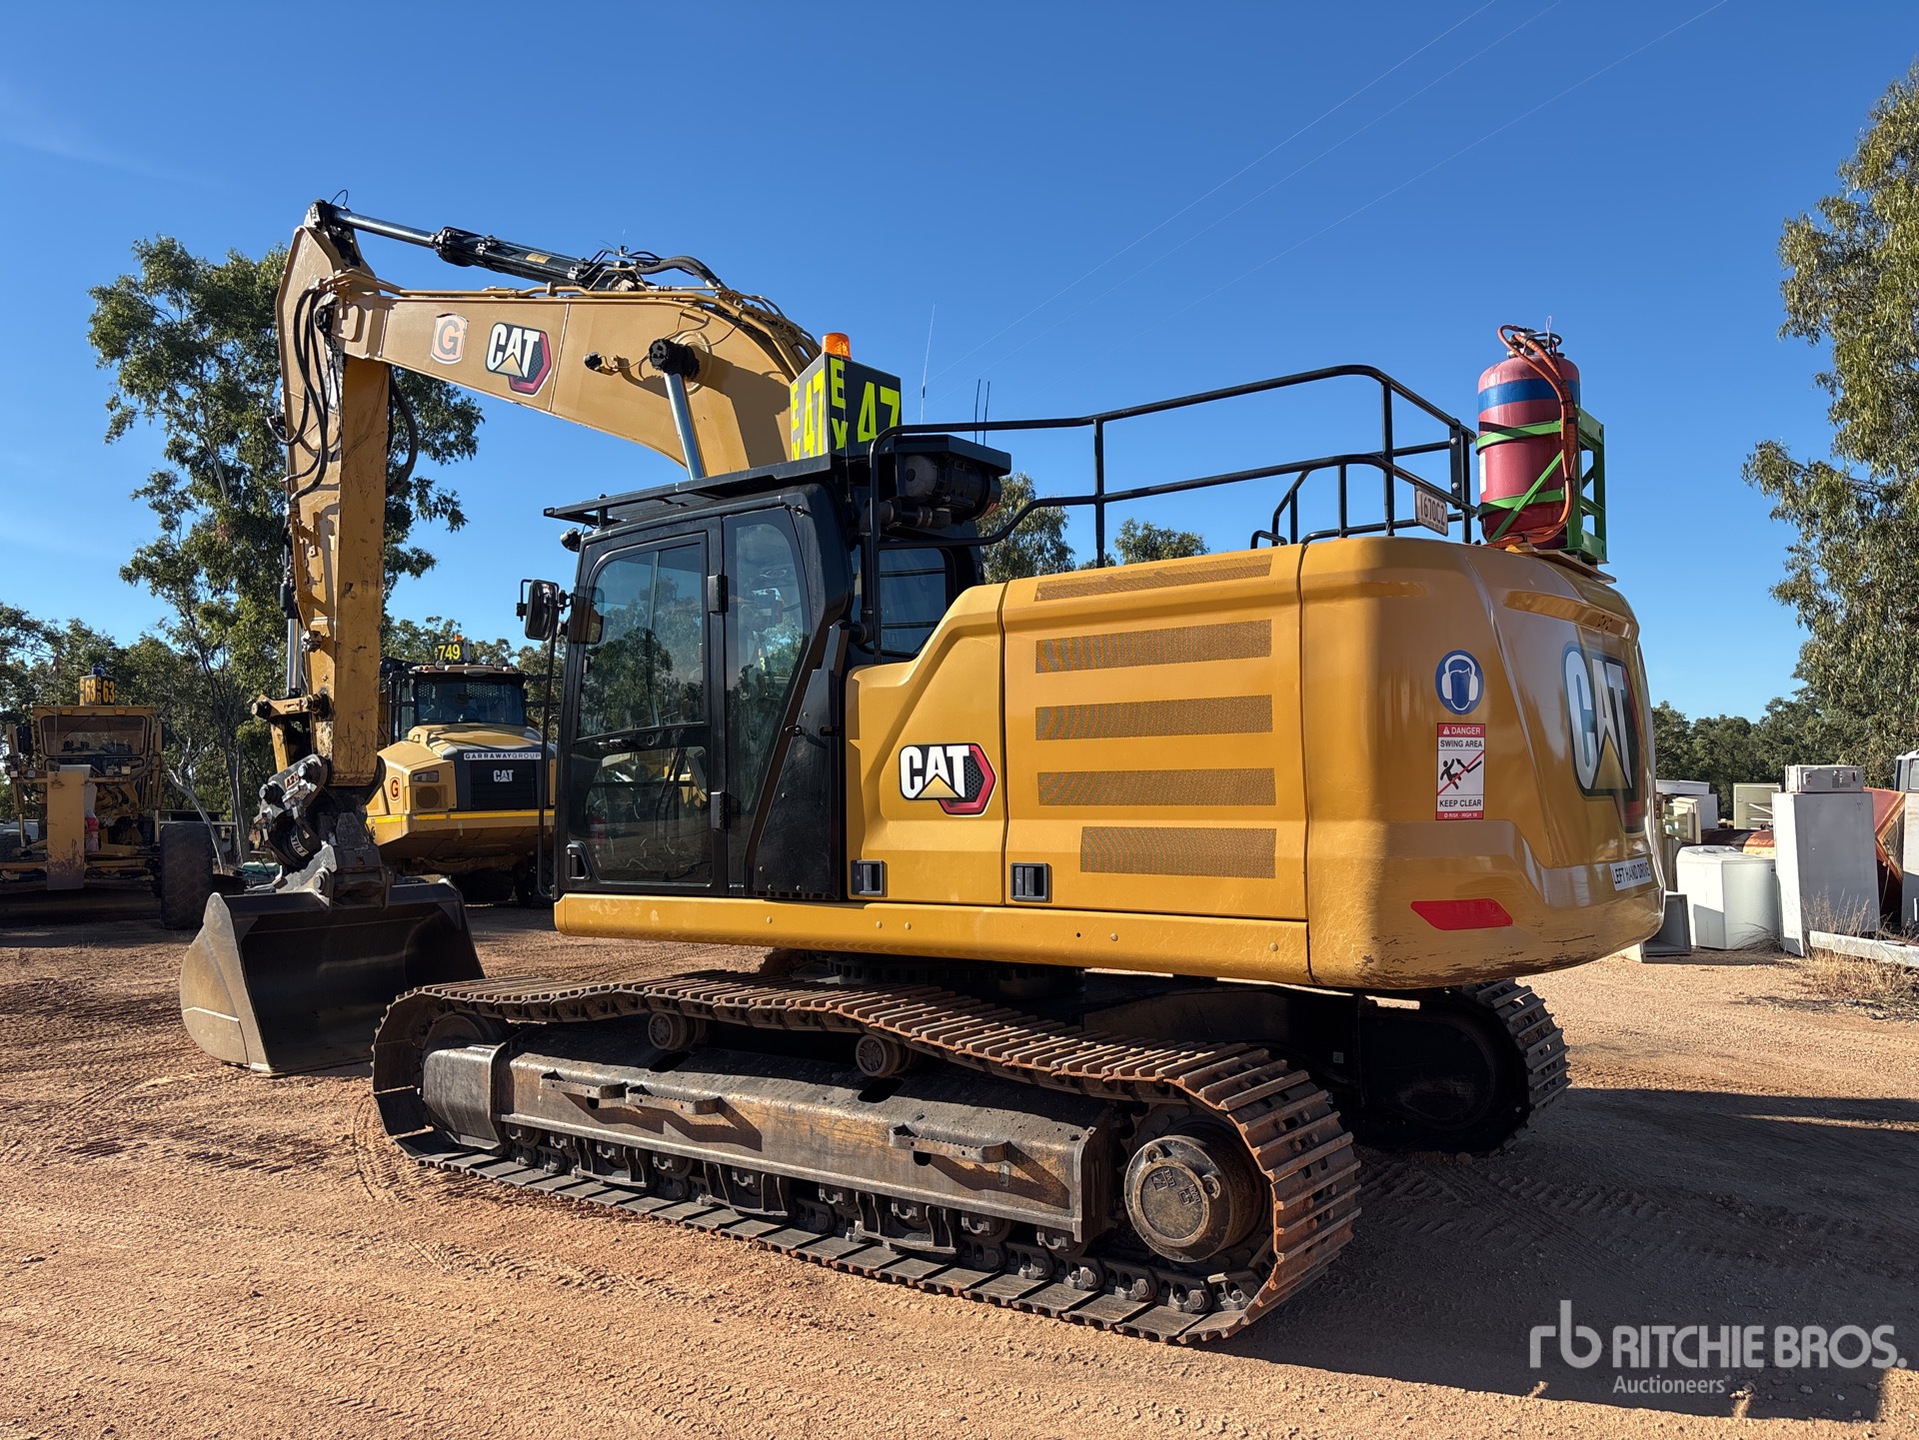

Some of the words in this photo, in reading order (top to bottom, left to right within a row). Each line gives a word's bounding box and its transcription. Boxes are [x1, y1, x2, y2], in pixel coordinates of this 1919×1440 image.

[437, 320, 460, 356] G
[486, 323, 541, 378] CAT
[803, 368, 825, 458] 47
[857, 381, 900, 443] 47
[438, 644, 460, 660] 749
[86, 679, 96, 702] 63
[102, 680, 115, 704] 63
[1451, 726, 1481, 735] DANGER
[1565, 650, 1633, 790] CAT
[1440, 740, 1464, 748] SWING
[1465, 740, 1482, 748] AREA
[493, 769, 514, 782] CAT
[900, 744, 970, 799] CAT
[390, 780, 398, 798] G
[1439, 800, 1458, 808] KEEP
[1460, 799, 1482, 808] CLEAR
[1612, 867, 1625, 884] LEFT
